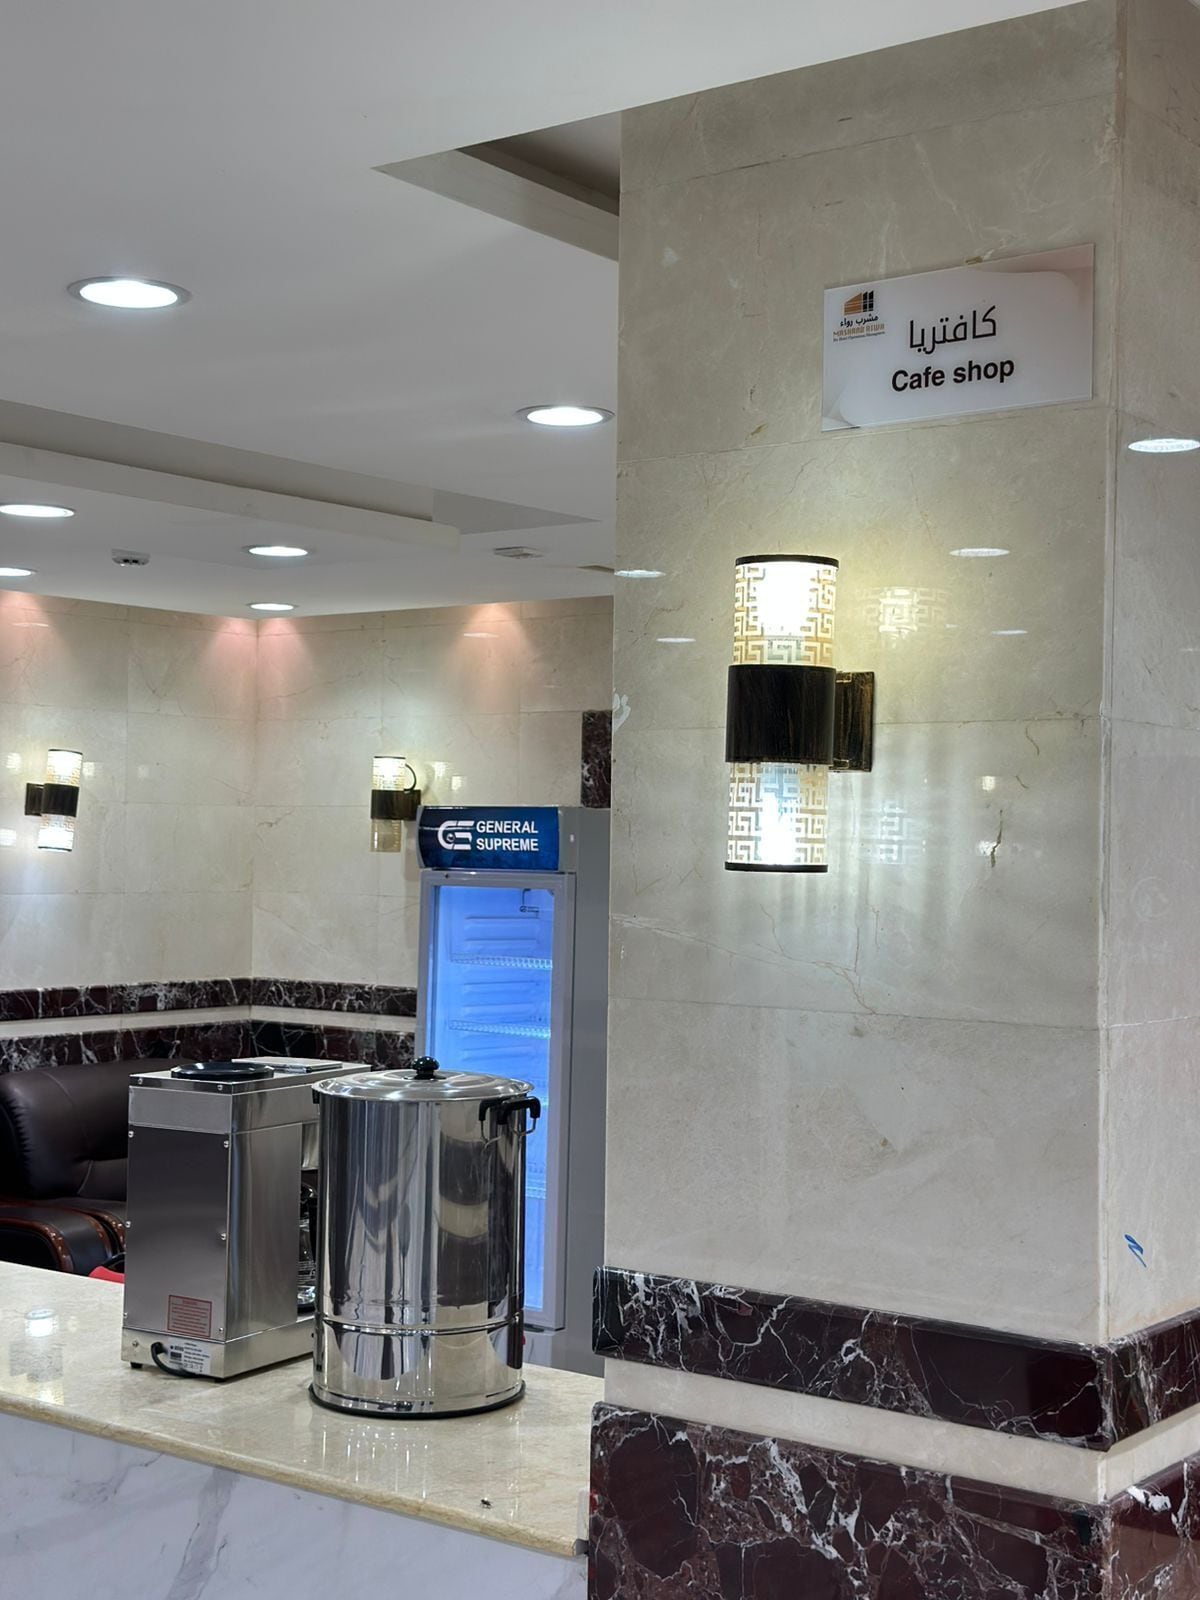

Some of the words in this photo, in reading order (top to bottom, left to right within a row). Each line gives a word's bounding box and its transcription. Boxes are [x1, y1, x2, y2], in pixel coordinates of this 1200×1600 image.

[909, 305, 997, 355] كافتريا
[892, 366, 945, 392] Cafe
[953, 359, 1015, 384] shop
[476, 820, 539, 834] GENERAL
[476, 838, 540, 851] SUPREME
